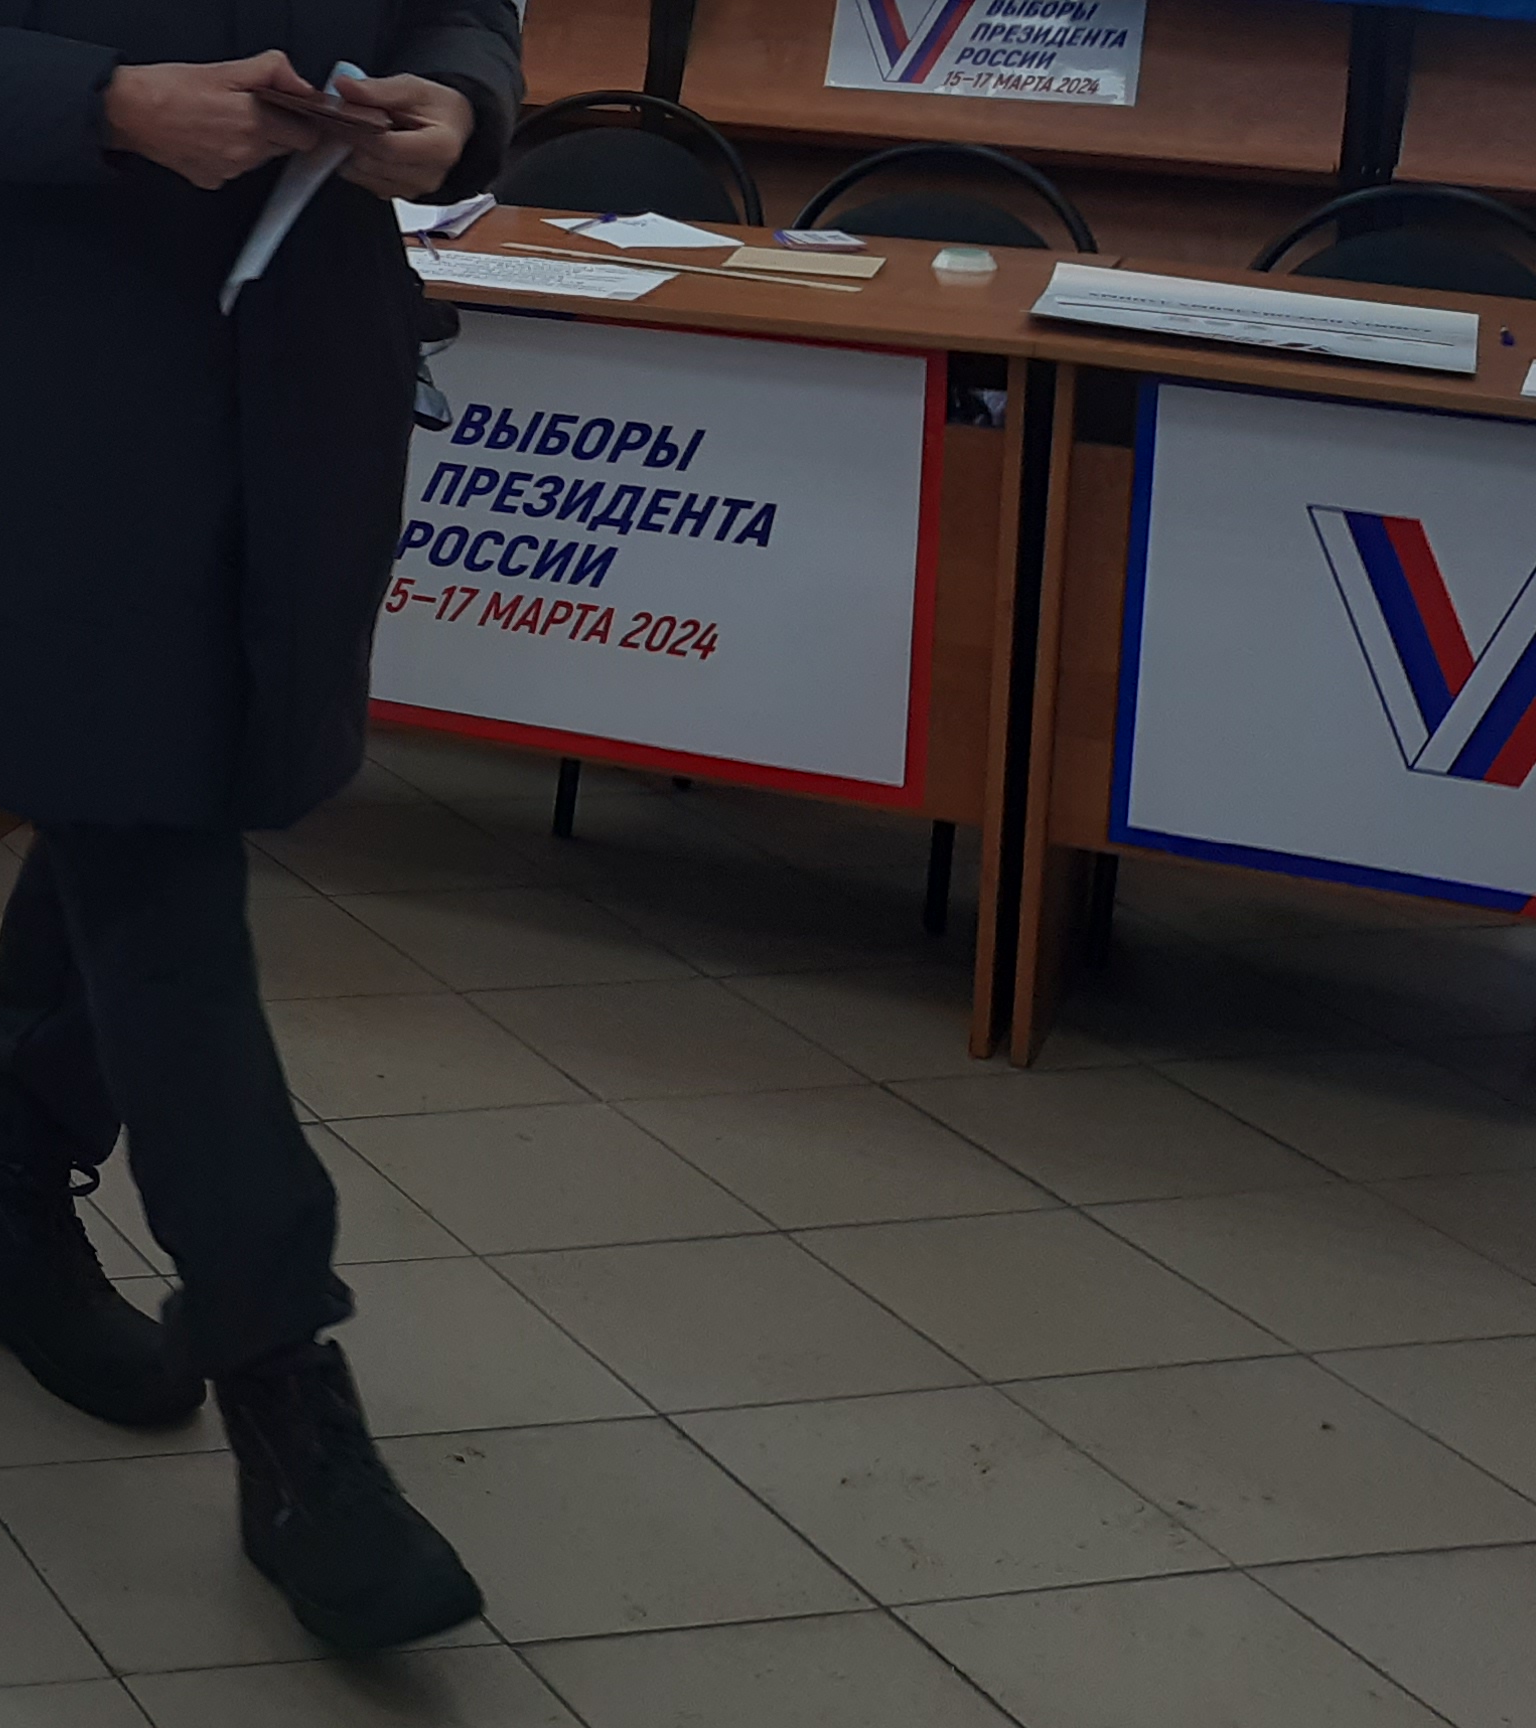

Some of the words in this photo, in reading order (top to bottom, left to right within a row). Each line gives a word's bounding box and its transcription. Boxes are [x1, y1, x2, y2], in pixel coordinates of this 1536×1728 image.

[954, 47, 1057, 70] РОССИИ
[969, 23, 1129, 49] ПРЕЗИДЕНТА
[992, 74, 1052, 92] МАРТА
[1054, 76, 1100, 95] 2024
[450, 403, 706, 472] ВЫБОРЫ
[420, 462, 778, 547] ПРЕЗИДЕНТА
[394, 519, 618, 588] РОССИИ
[384, 576, 480, 622] 5–17
[477, 590, 616, 644] МАРТА
[618, 611, 719, 660] 2024
